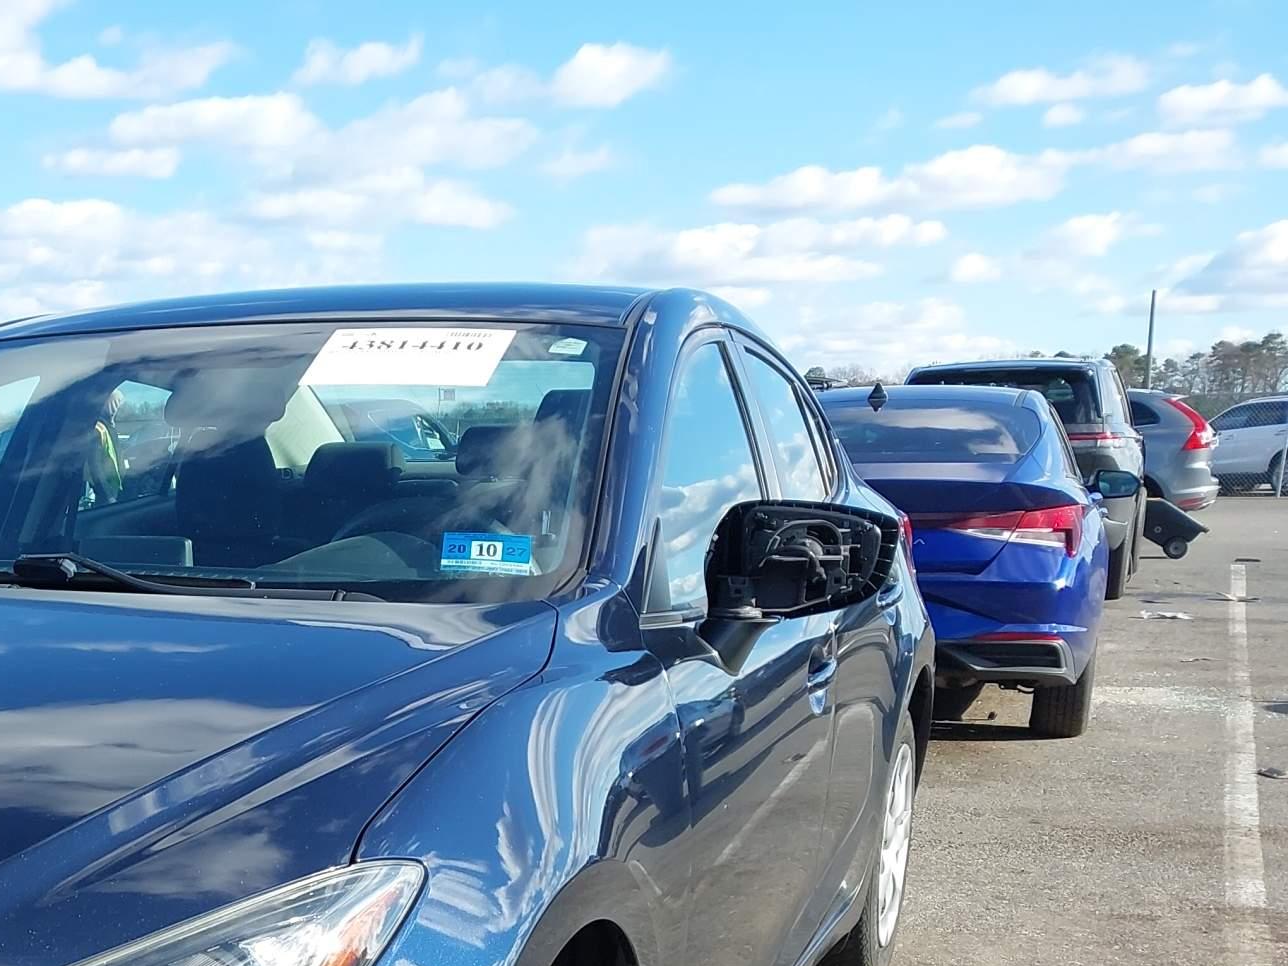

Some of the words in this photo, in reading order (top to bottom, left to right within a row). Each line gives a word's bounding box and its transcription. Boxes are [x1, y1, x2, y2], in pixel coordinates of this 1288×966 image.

[447, 543, 467, 554] 20
[475, 542, 498, 558] 10
[506, 546, 528, 558] 27
